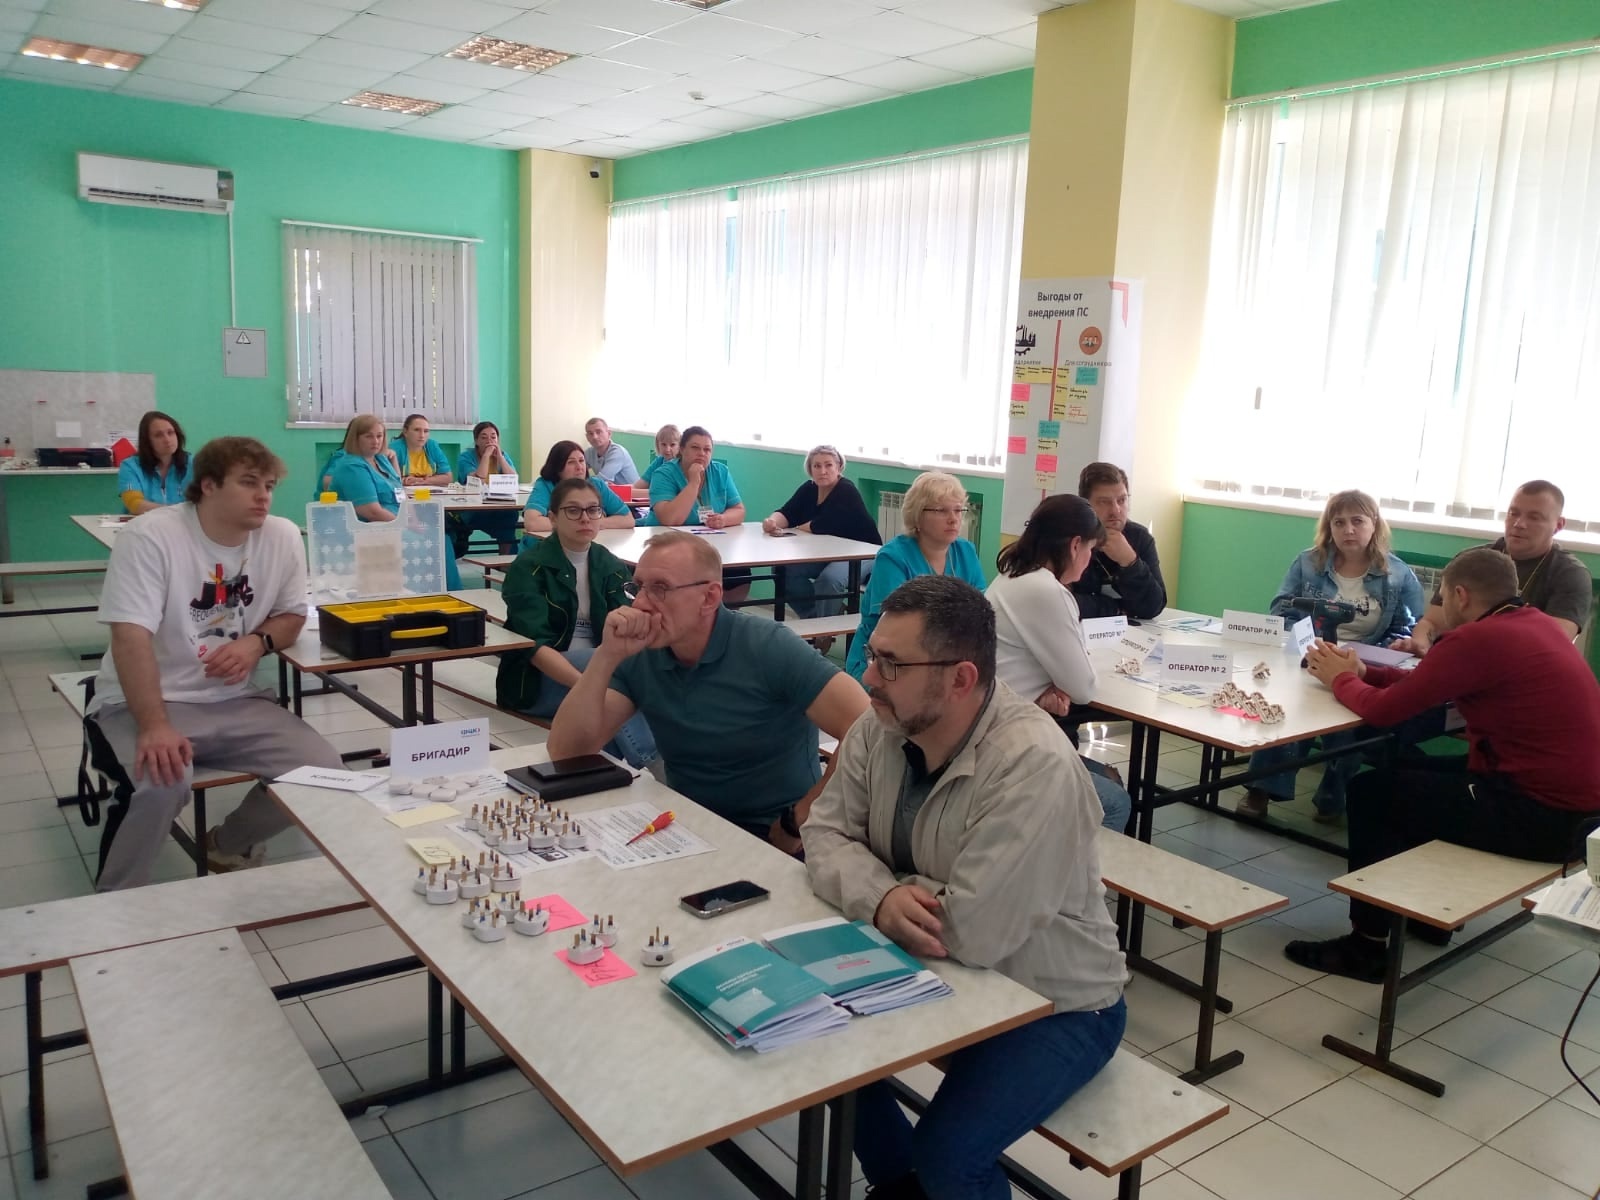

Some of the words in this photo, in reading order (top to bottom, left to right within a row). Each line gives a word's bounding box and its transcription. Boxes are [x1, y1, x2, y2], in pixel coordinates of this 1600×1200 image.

[1037, 292, 1072, 303] Выгоды
[1073, 292, 1083, 301] от
[1028, 309, 1075, 319] внедрения
[1076, 307, 1089, 317] ПС
[1227, 623, 1263, 634] ОПЕРАТОР
[1168, 663, 1210, 673] ОПЕРАТОР
[411, 746, 471, 763] БРИГАДИР
